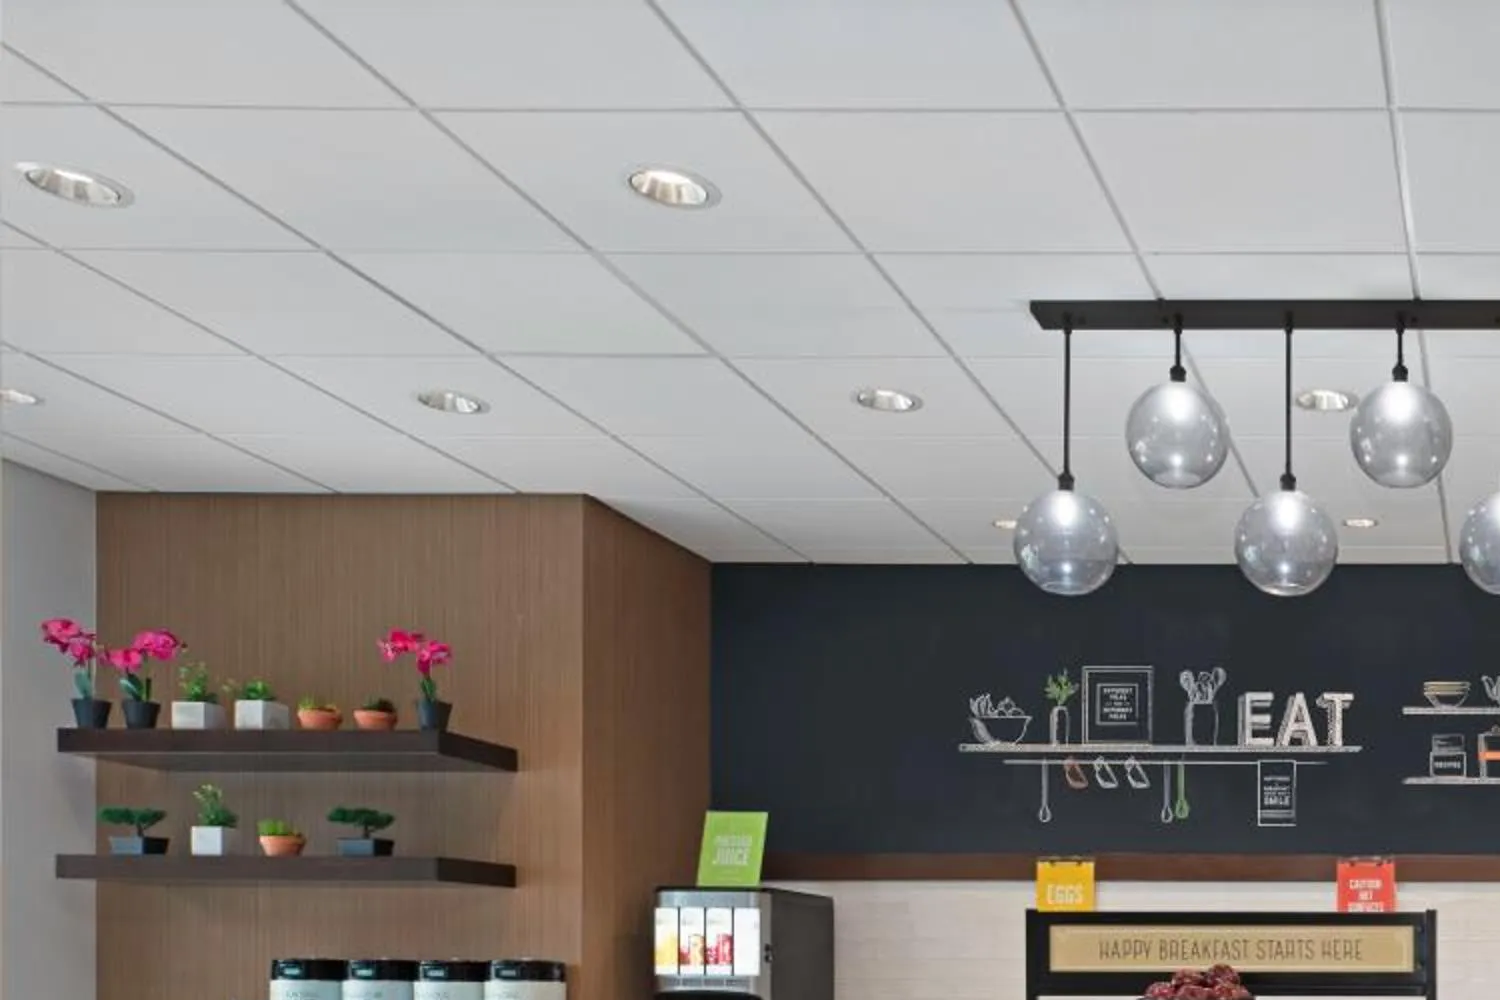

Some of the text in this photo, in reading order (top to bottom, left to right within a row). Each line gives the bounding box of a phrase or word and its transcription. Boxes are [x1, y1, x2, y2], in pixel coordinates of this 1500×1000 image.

[1238, 692, 1355, 747] EAT
[1047, 884, 1083, 905] EGGS
[1100, 939, 1363, 961] HAPPY BREAKFAST STARTS HERE
